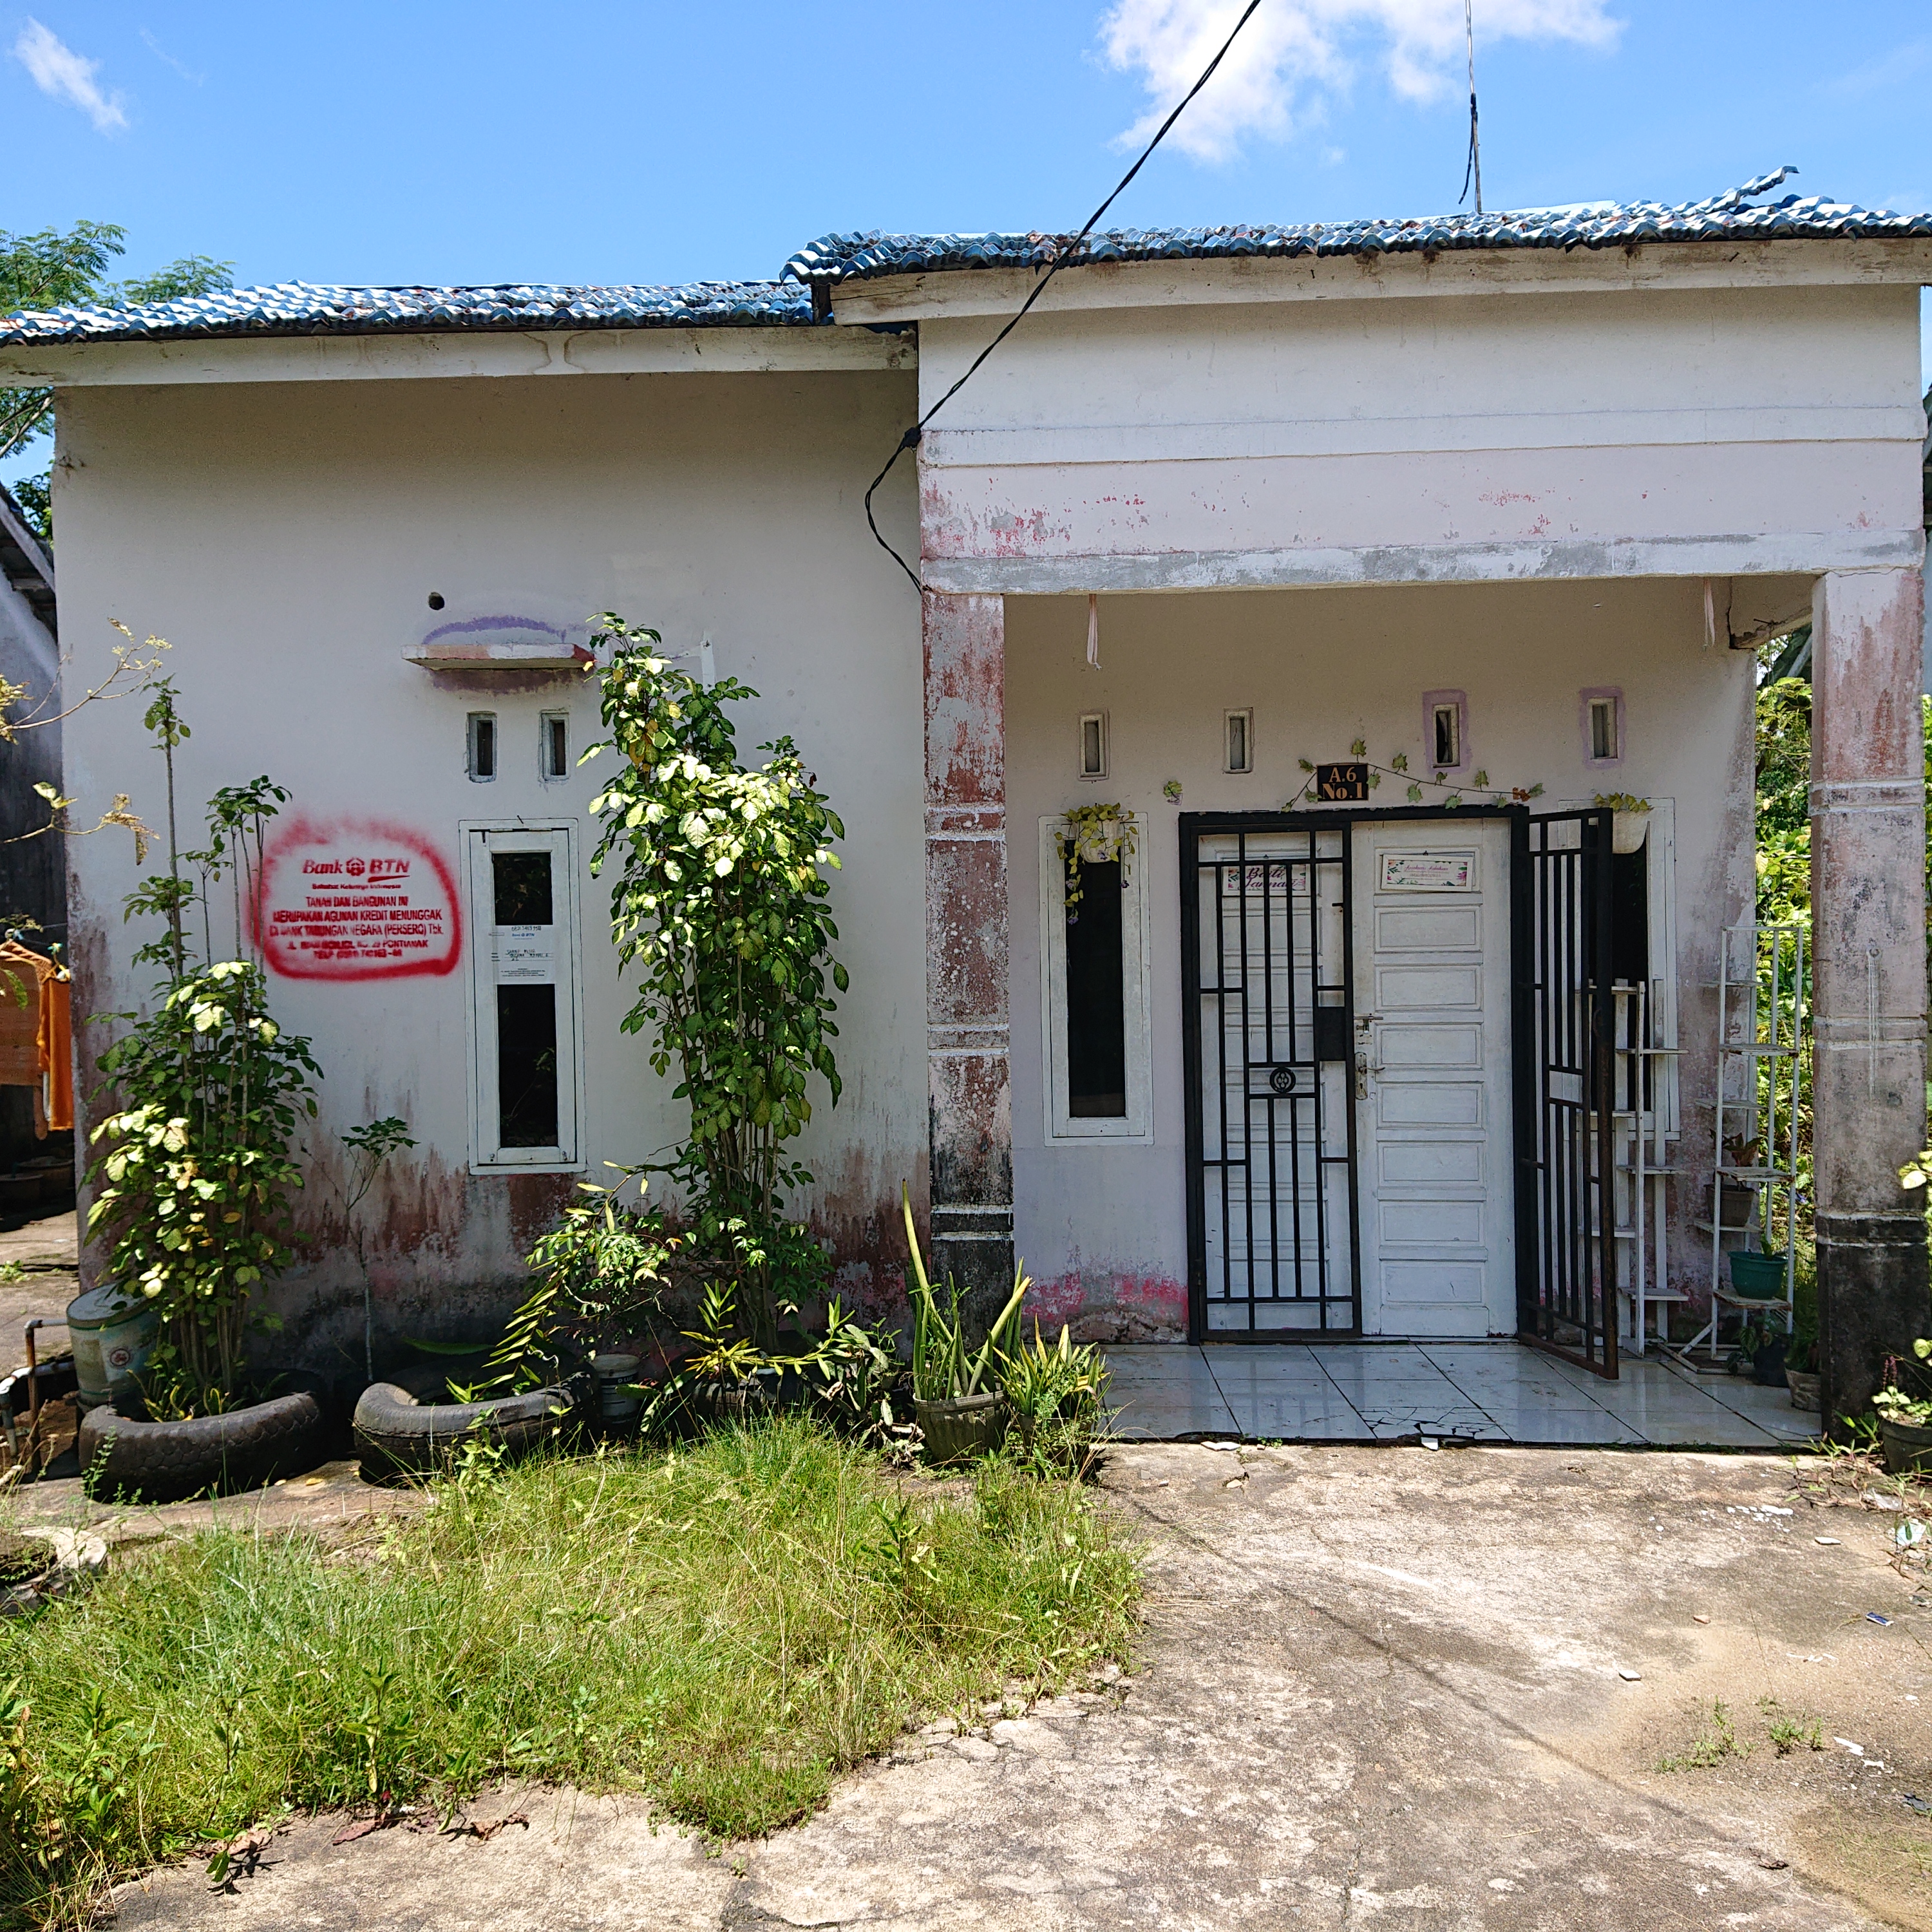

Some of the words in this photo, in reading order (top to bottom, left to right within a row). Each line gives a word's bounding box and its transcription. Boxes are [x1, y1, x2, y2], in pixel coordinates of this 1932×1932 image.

[1329, 766, 1357, 782] A.6
[302, 859, 343, 874] Bank
[369, 858, 411, 874] BTN
[1245, 878, 1298, 887] Jannai
[306, 896, 332, 907] TANAH
[334, 896, 351, 907] DAN
[352, 896, 396, 907] BANGUNAN
[398, 896, 408, 907] INI
[273, 910, 323, 923] MERUPAKAN
[324, 910, 358, 922] AGUNAN
[360, 910, 388, 921] KREDIT
[390, 909, 442, 921] MENUNGGAK
[304, 925, 348, 936] TABUNGAN
[350, 925, 383, 936] NEGARA
[384, 923, 426, 938] (PERSERO)
[383, 940, 430, 949] PONTIANAK
